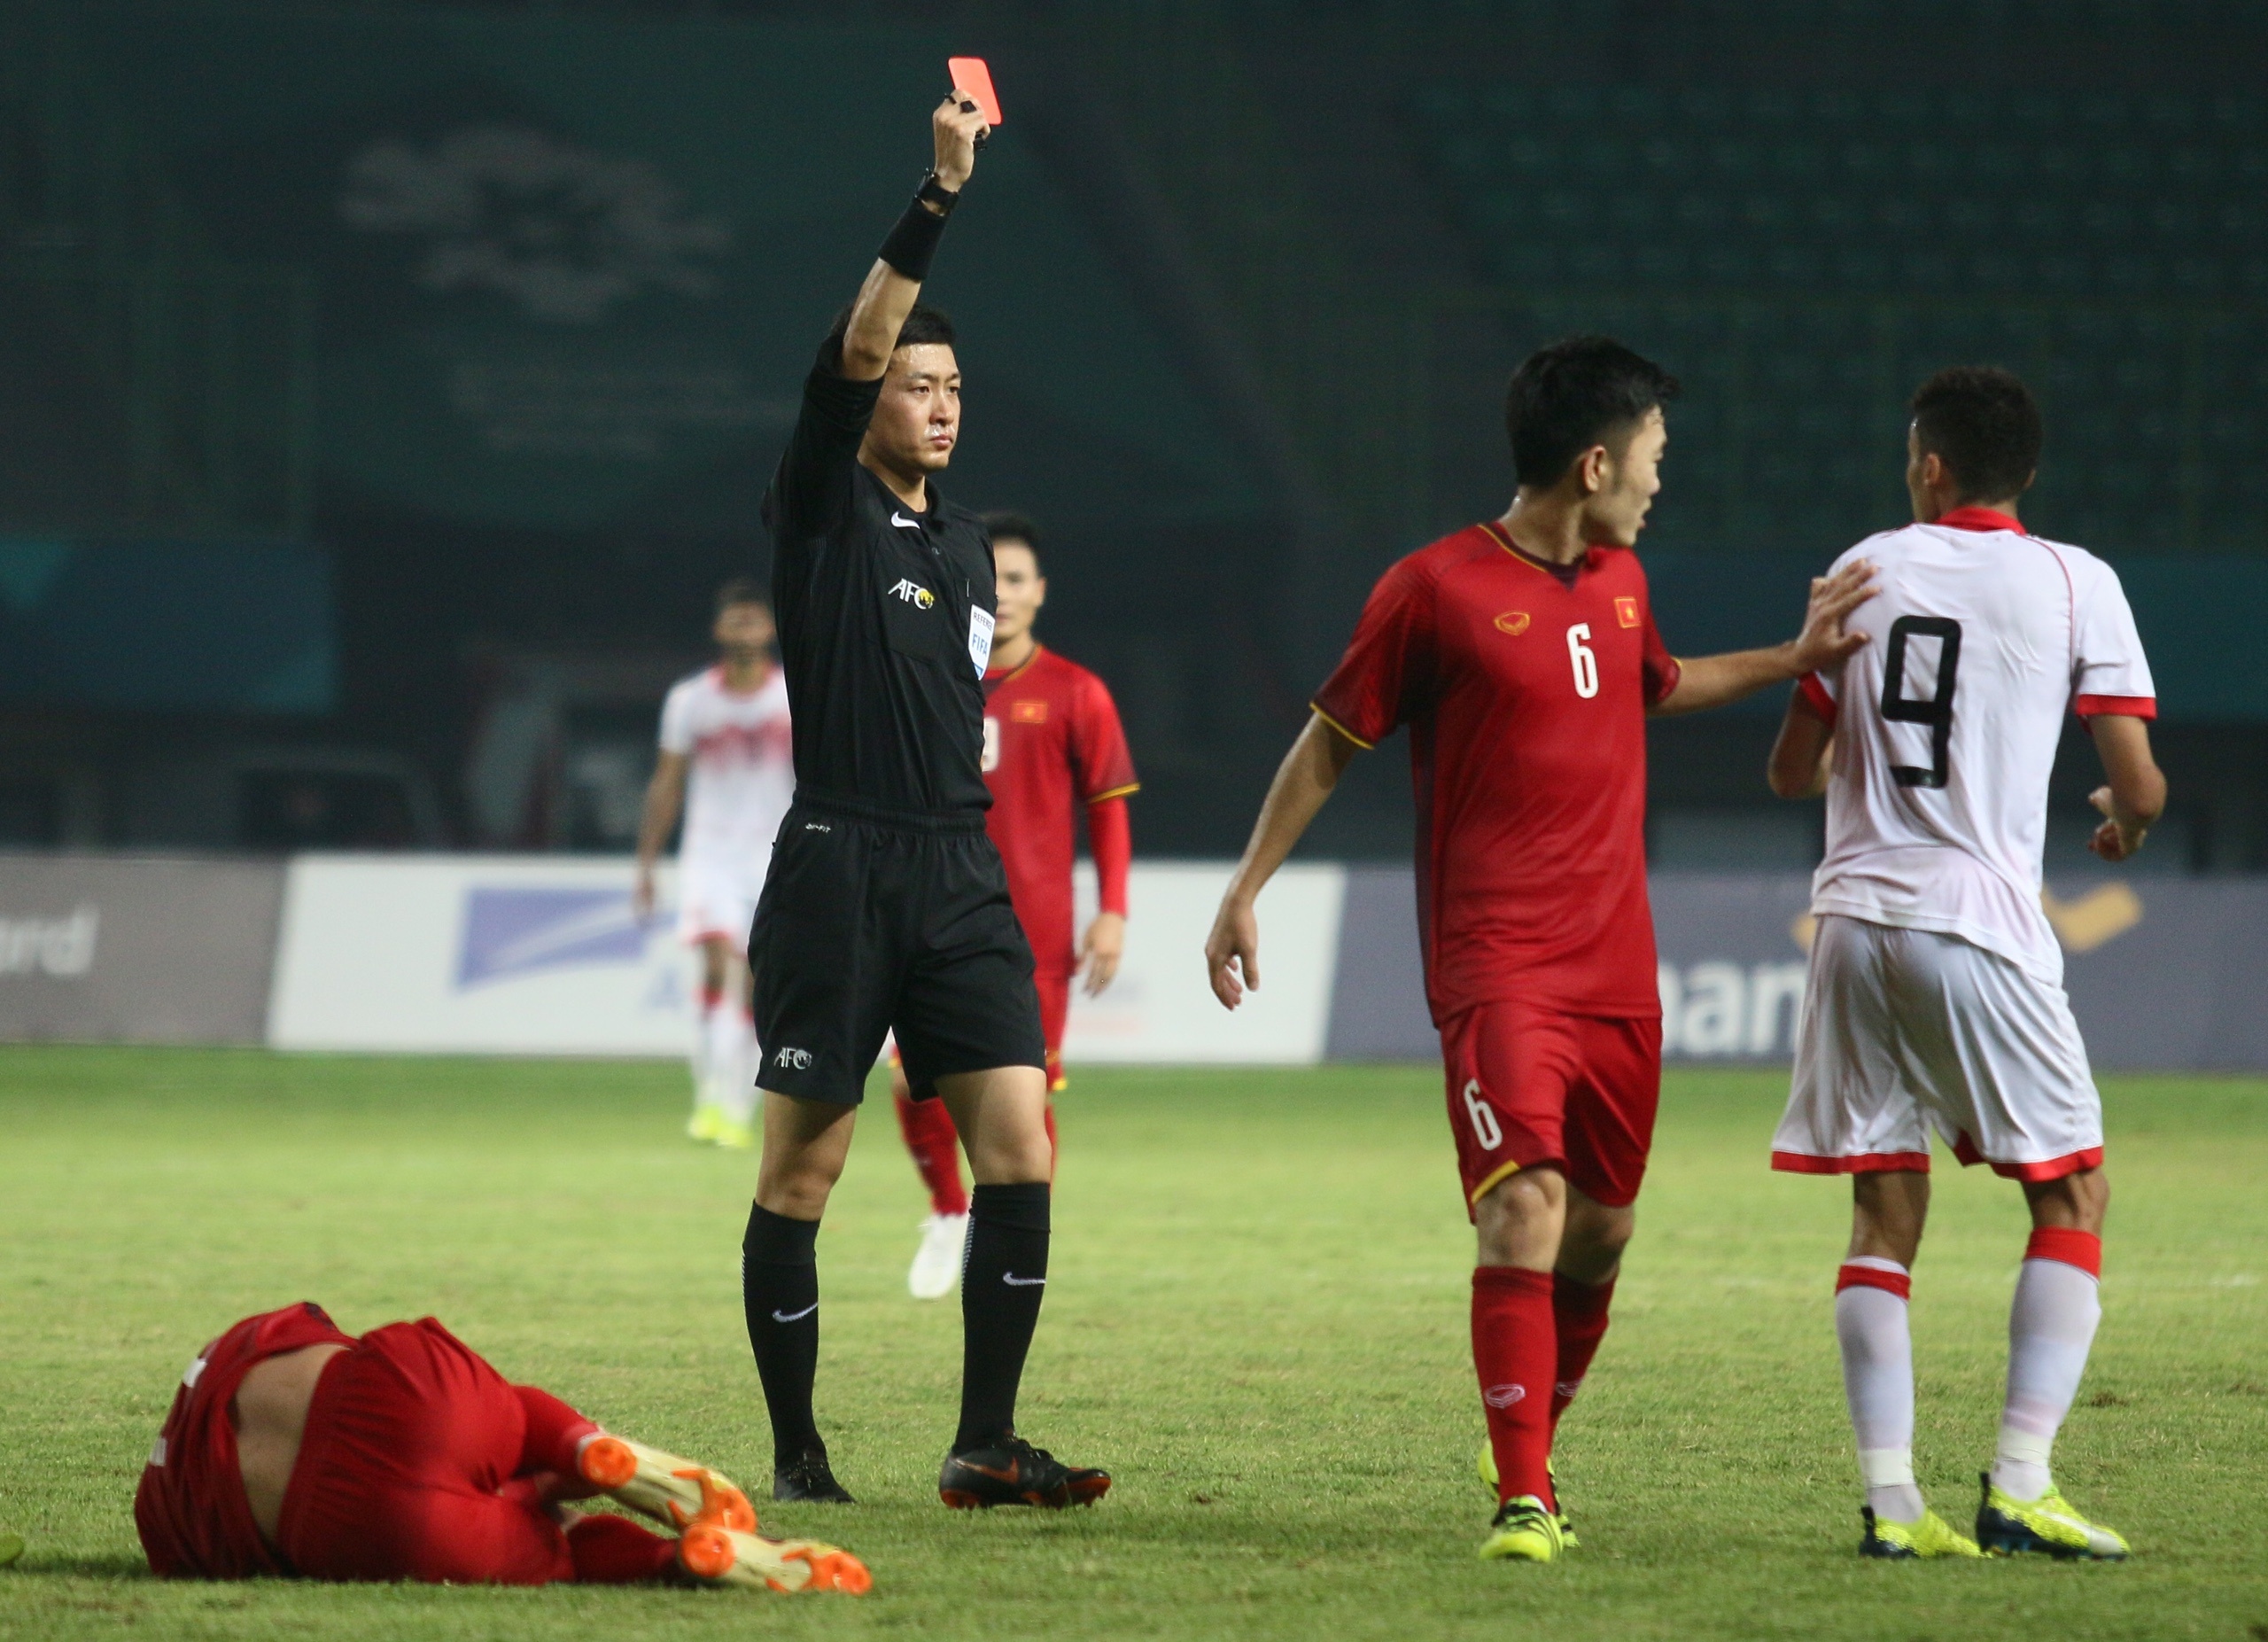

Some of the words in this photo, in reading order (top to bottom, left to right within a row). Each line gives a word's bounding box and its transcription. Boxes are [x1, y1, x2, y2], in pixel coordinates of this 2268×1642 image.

[887, 577, 934, 610] AFC
[973, 611, 992, 631] REFEREE
[972, 633, 988, 657] FIFA
[1566, 623, 1599, 699] 6
[1881, 614, 1961, 789] 9
[773, 1047, 812, 1070] AFC
[1464, 1077, 1503, 1151] 6
